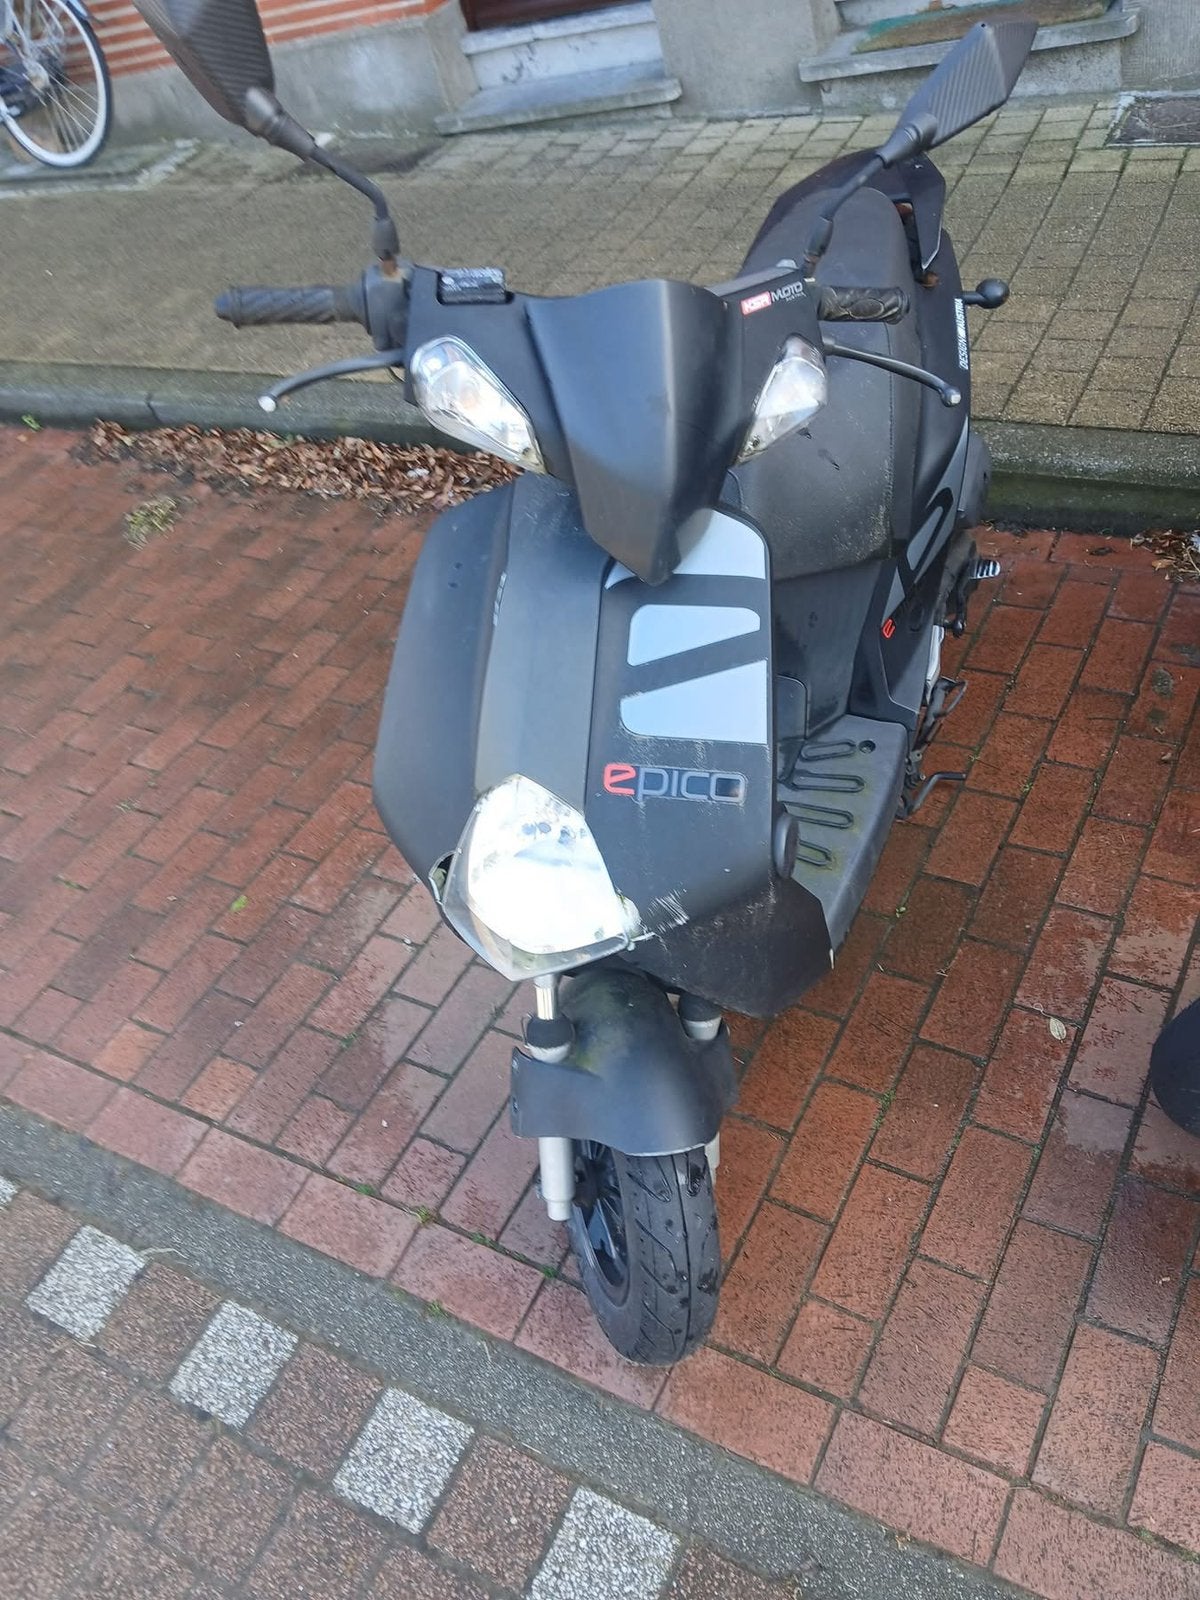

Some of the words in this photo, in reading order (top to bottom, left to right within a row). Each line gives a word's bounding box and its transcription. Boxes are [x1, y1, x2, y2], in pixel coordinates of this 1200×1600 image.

[771, 281, 803, 302] MOTO
[958, 336, 969, 370] DESIGN
[603, 763, 746, 802] epico
